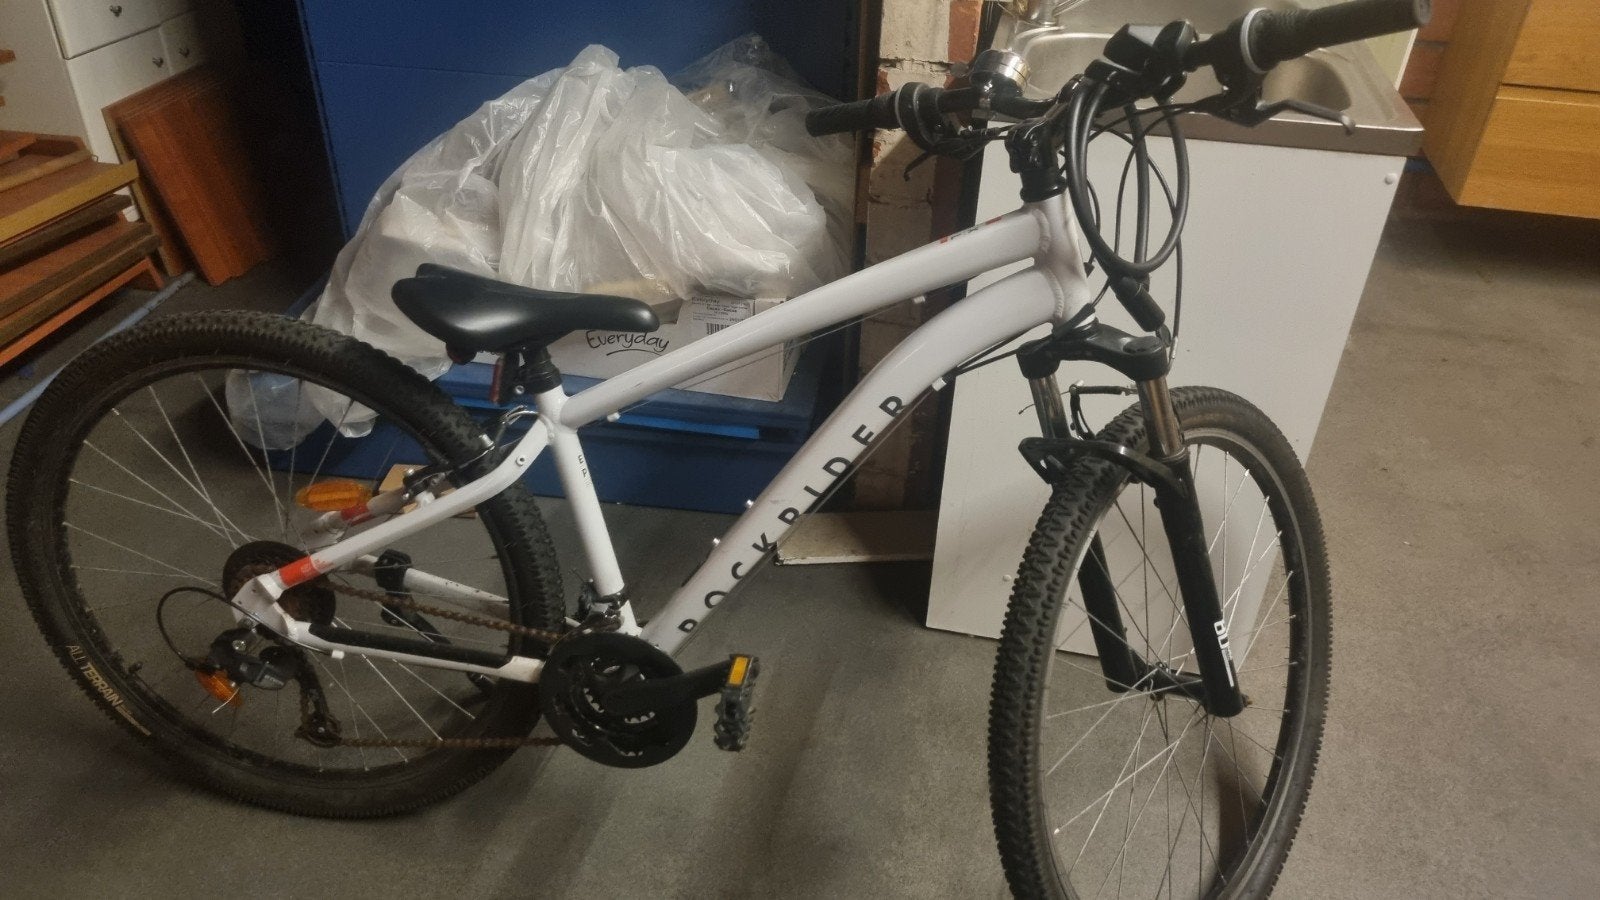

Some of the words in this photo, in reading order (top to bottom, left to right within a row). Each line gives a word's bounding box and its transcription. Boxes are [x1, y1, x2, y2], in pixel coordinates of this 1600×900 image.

[586, 330, 670, 352] Everyday
[678, 395, 905, 633] ROCKRIDER
[66, 645, 86, 662] ALL
[80, 661, 124, 707] TERRAIN
